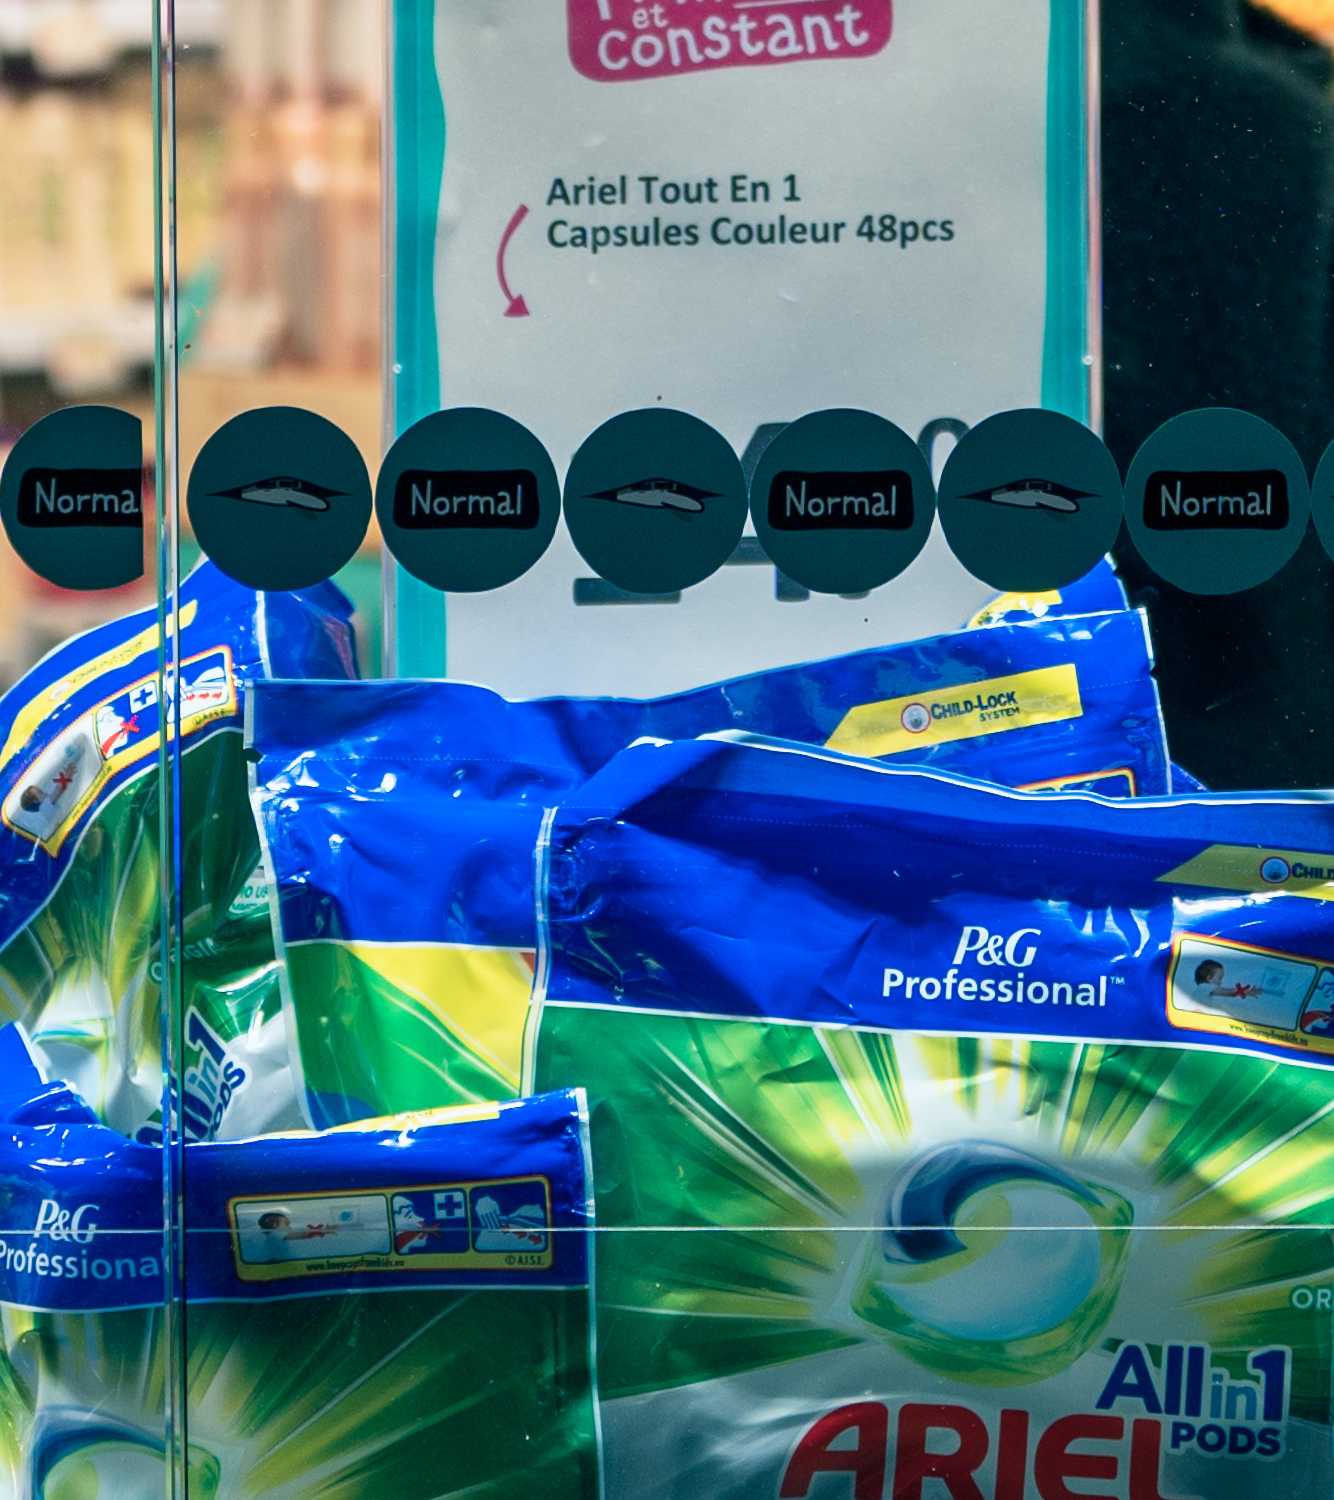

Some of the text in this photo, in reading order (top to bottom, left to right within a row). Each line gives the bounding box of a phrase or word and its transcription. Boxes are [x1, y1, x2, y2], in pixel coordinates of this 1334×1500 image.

[632, 3, 668, 29] et
[598, 5, 869, 71] constant
[546, 174, 801, 206] Ariel Tout En 1
[547, 214, 955, 254] Capsules Couleur 48pcs
[411, 479, 522, 516] Normal
[786, 480, 897, 517] Normal
[1161, 480, 1272, 517] Normal
[952, 926, 1042, 968] P&G
[33, 1199, 100, 1244] P&G
[1171, 1422, 1281, 1456] PODS
